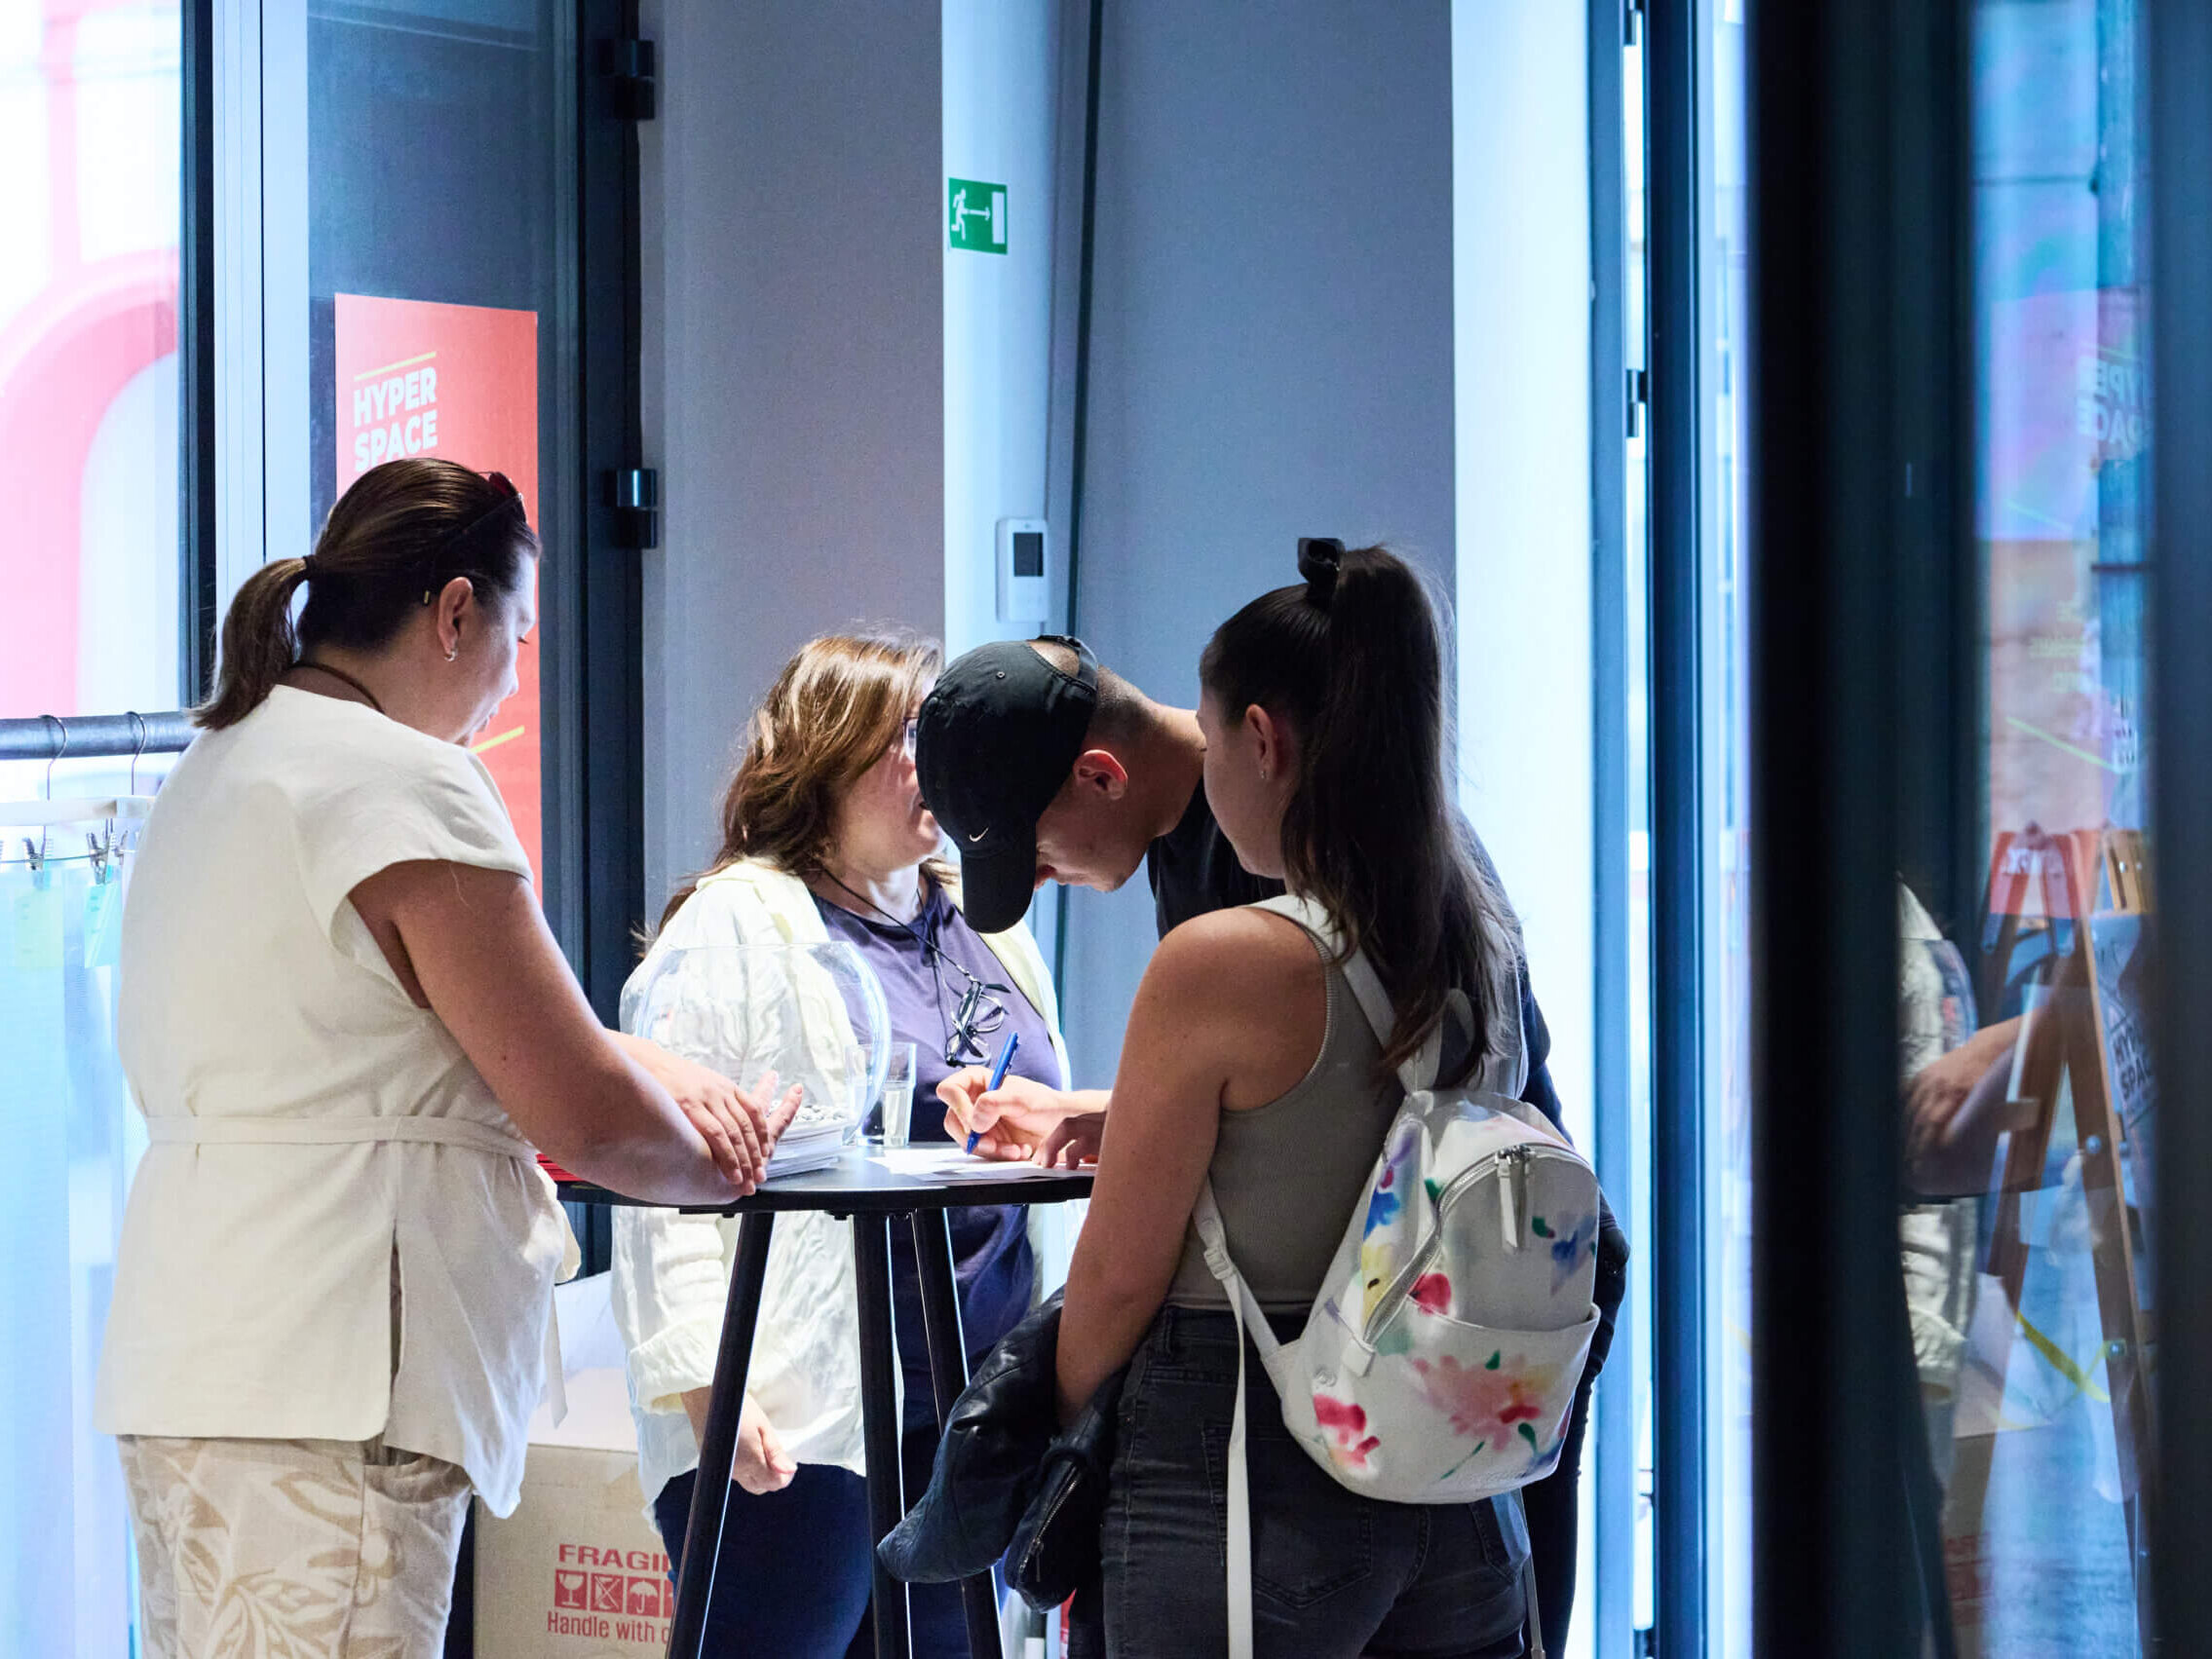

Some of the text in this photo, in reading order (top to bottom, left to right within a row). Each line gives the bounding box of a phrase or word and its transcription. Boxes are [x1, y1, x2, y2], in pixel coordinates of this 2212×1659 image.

[354, 366, 438, 429] HYPER
[355, 410, 439, 472] SPACE
[548, 1610, 610, 1640] Handle
[616, 1619, 655, 1643] with
